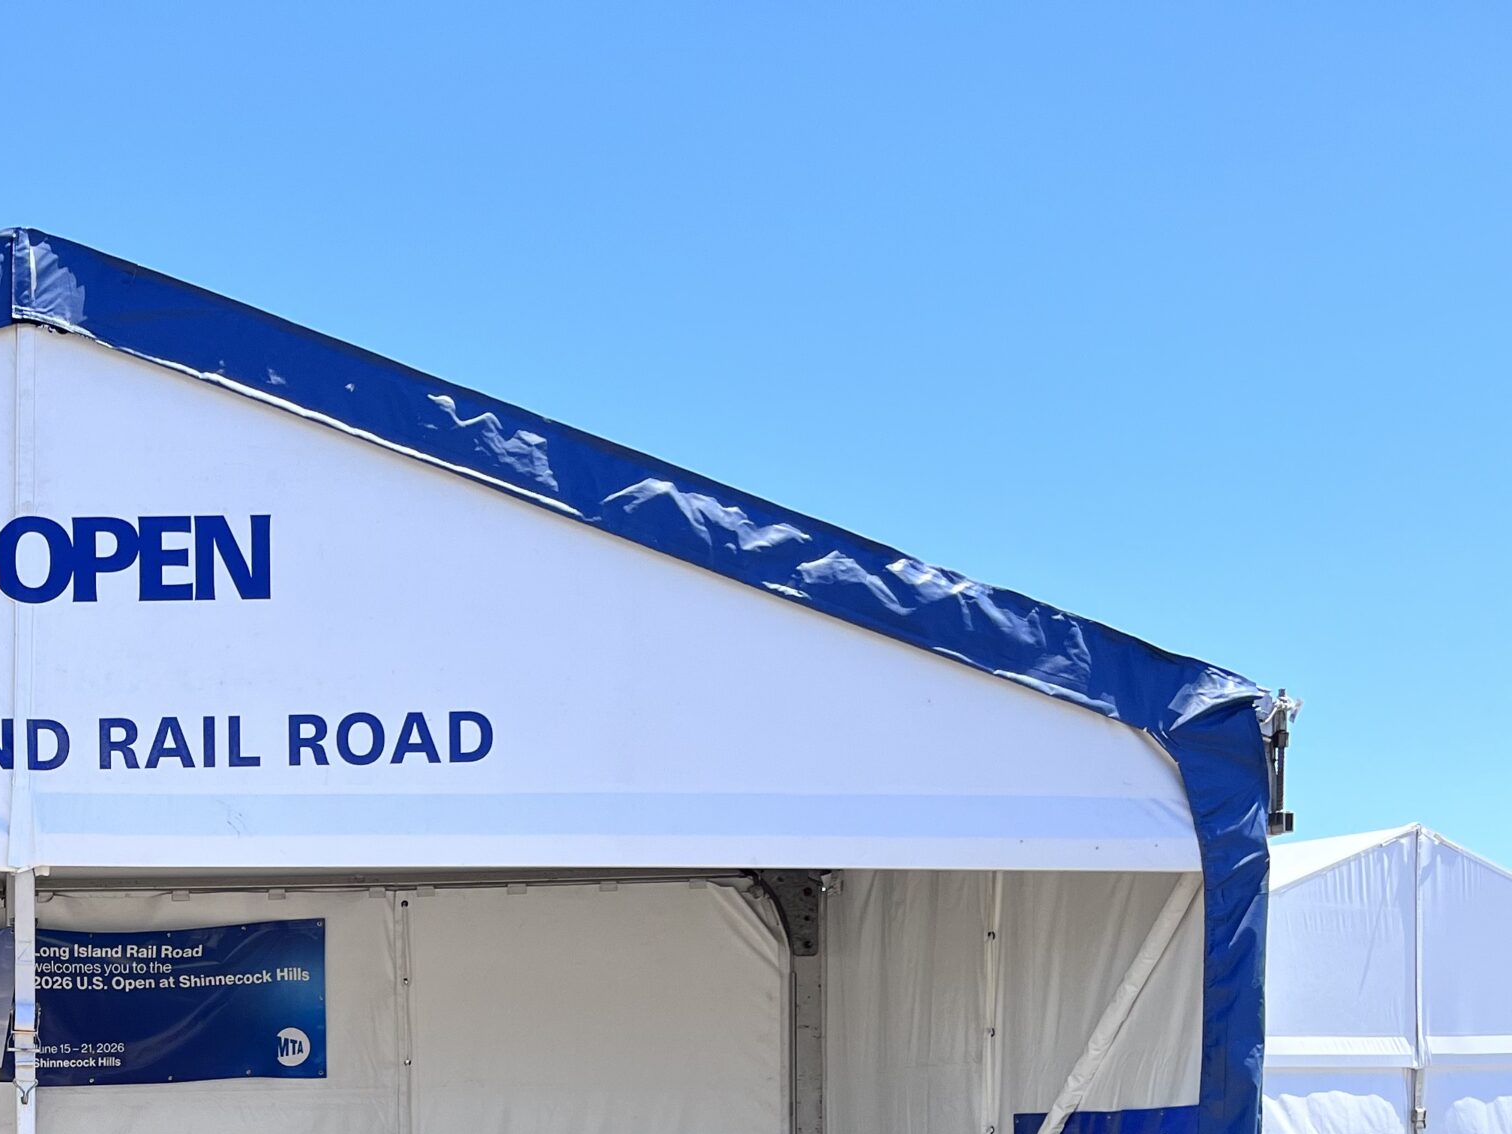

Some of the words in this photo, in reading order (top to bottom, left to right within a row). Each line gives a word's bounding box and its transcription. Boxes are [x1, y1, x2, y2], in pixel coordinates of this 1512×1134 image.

[98, 715, 260, 770] RAIL
[288, 711, 494, 766] ROAD
[35, 944, 69, 960] ong
[74, 944, 122, 958] Island
[126, 945, 156, 959] Rail
[161, 945, 203, 959] Road
[104, 963, 129, 976] you
[132, 961, 147, 974] to
[149, 961, 172, 974] the
[35, 976, 73, 990] 2026
[76, 976, 108, 990] U.S.
[111, 976, 156, 992] Open
[159, 977, 175, 989] at
[179, 970, 272, 987] Shinnecock
[276, 967, 310, 982] Hills
[60, 1043, 71, 1054] 15
[96, 1043, 125, 1053] 2026
[277, 1035, 304, 1058] MTA
[98, 1056, 121, 1067] Hills
